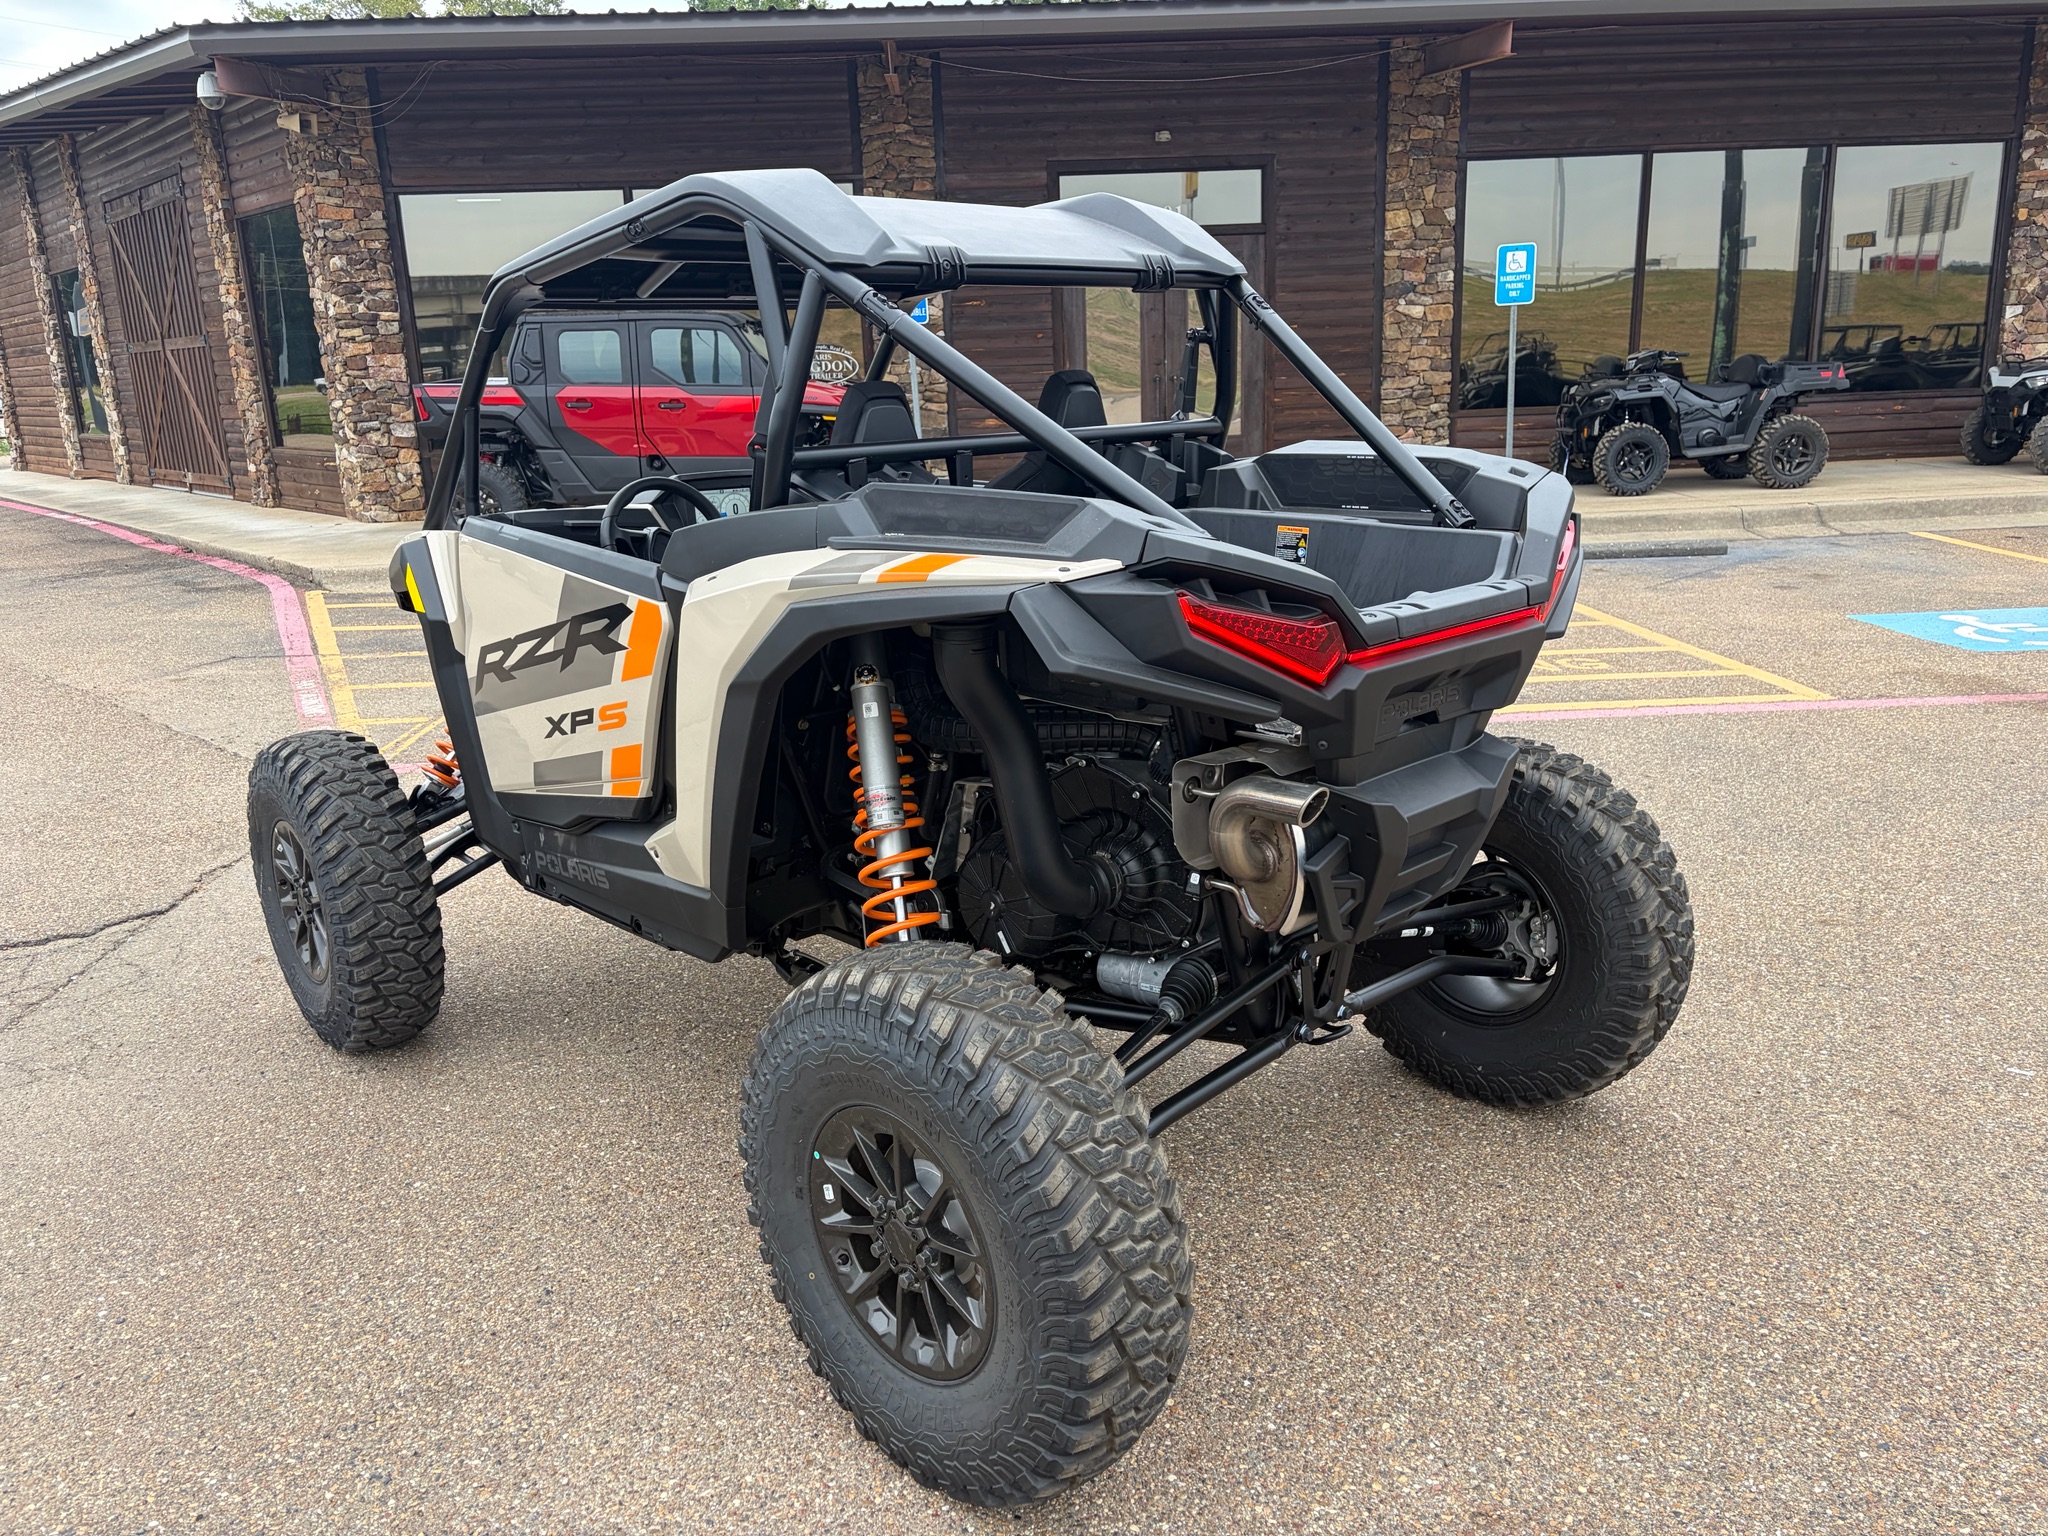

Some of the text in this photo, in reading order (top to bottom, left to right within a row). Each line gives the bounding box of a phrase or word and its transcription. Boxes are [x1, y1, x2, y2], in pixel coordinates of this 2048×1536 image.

[813, 353, 832, 361] ARIS
[475, 602, 634, 696] RZR
[1381, 685, 1460, 724] POLARIS
[535, 850, 610, 890] POLARIS
